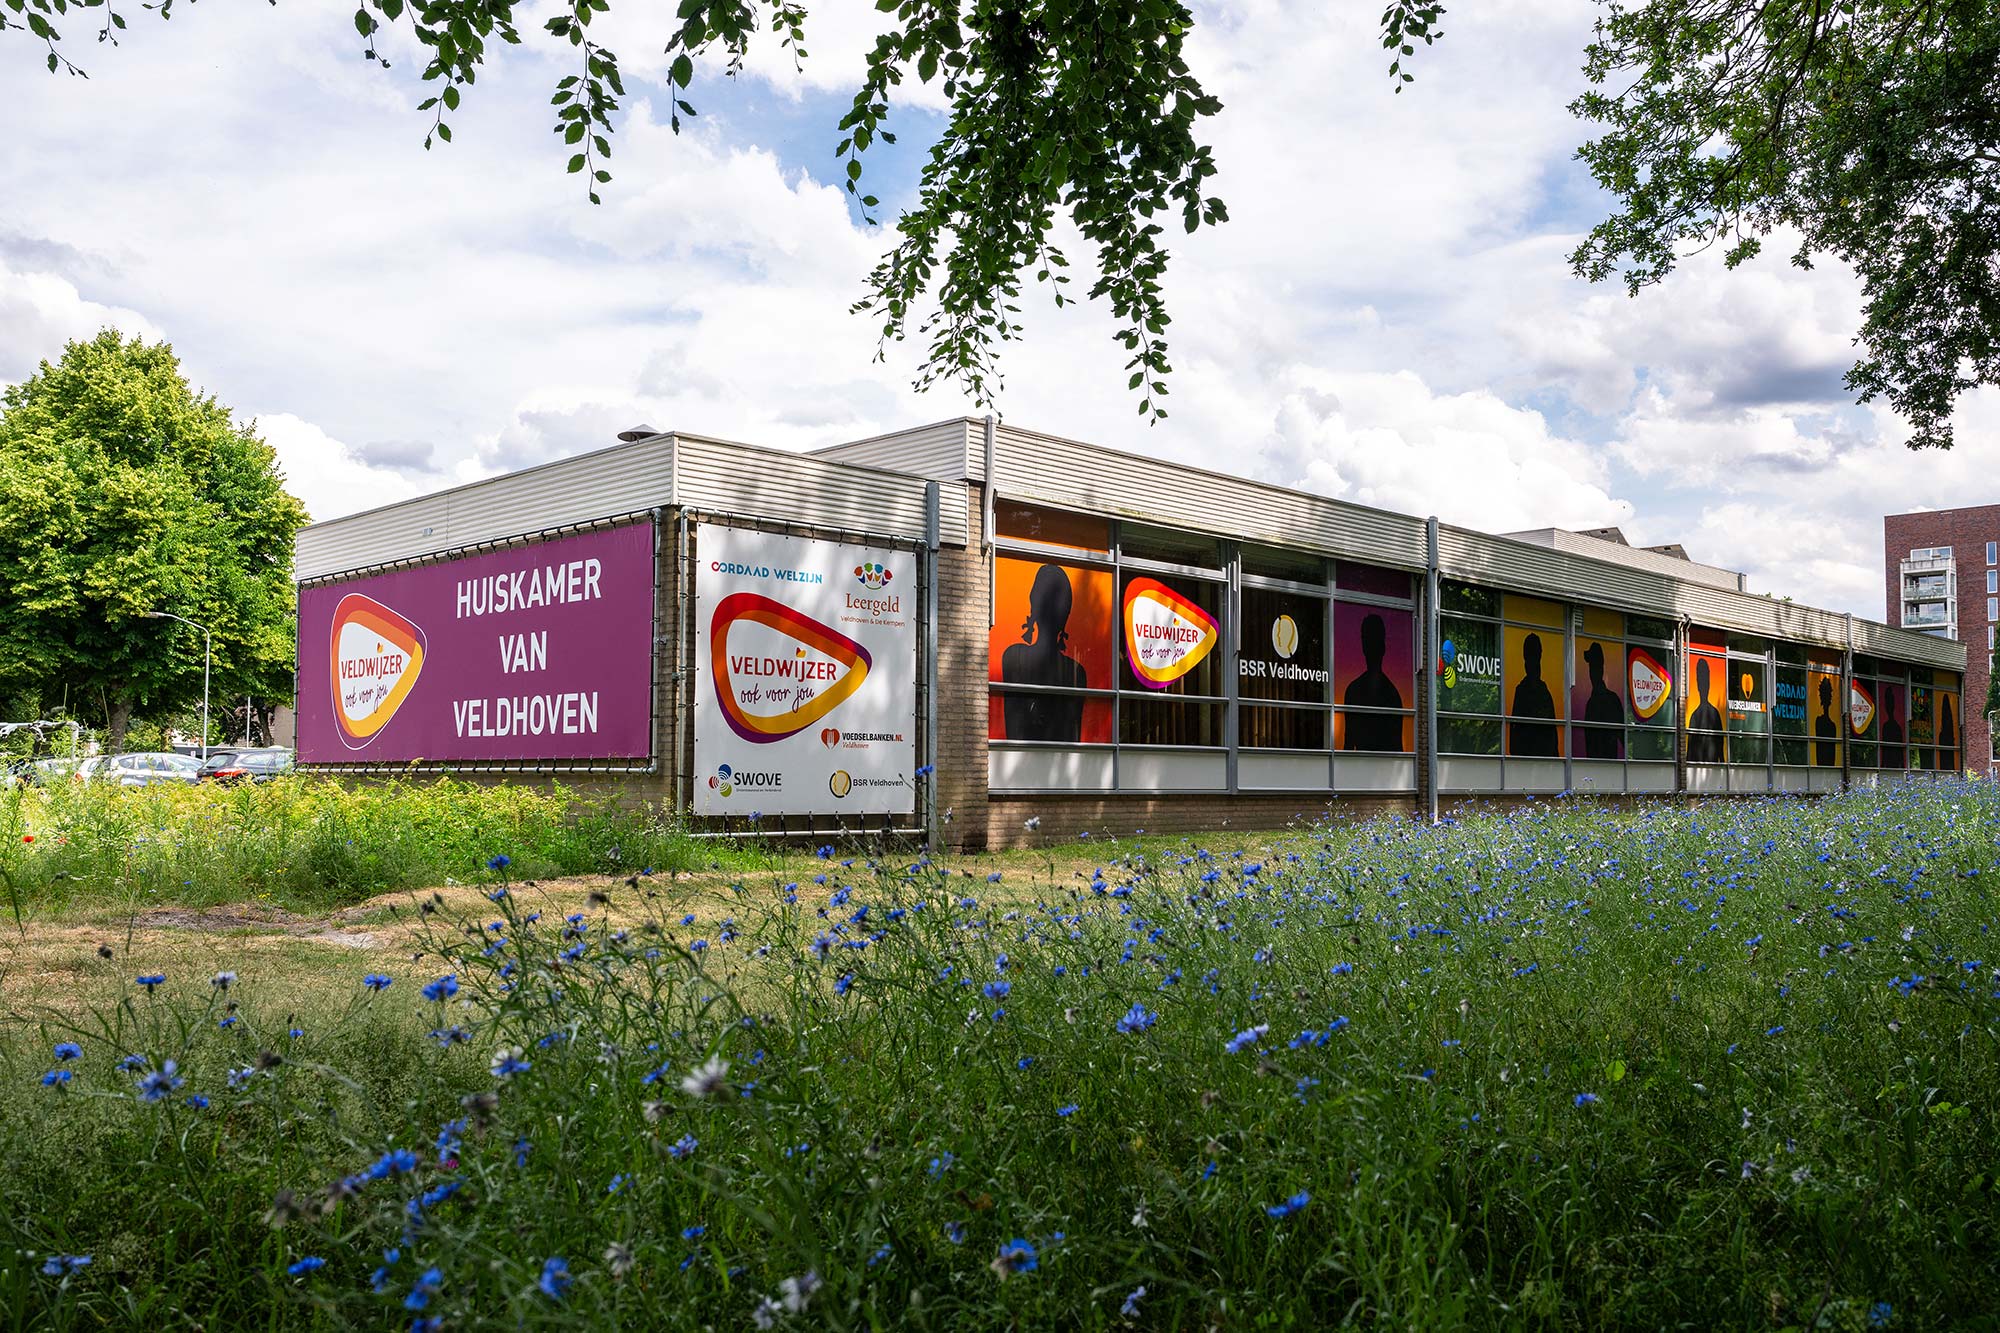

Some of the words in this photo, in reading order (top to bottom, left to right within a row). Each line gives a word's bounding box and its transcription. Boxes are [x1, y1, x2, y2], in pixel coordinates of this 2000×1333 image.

[773, 568, 823, 584] WELZIJN
[456, 558, 602, 619] HUISKAMER
[845, 593, 900, 616] Leergeld
[1136, 623, 1199, 644] VELDWIJZER
[499, 630, 547, 674] VAN
[341, 654, 402, 680] VELDWIJZER
[731, 655, 837, 682] VELDWIJZER
[1239, 659, 1266, 678] BSR
[1269, 661, 1329, 683] Veldhoven
[1457, 653, 1501, 676] SWOVE
[741, 683, 762, 704] ook
[765, 688, 791, 702] voor
[792, 684, 815, 713] jou
[1776, 683, 1806, 700] ORDAAD
[453, 691, 598, 738] VELDHOVEN
[1774, 703, 1805, 720] WELZIJN
[842, 732, 904, 742] VOEDSELBANKEN.NL
[734, 772, 782, 786] SWOVE
[853, 779, 868, 787] BSR
[869, 779, 904, 787] Veldhoven
